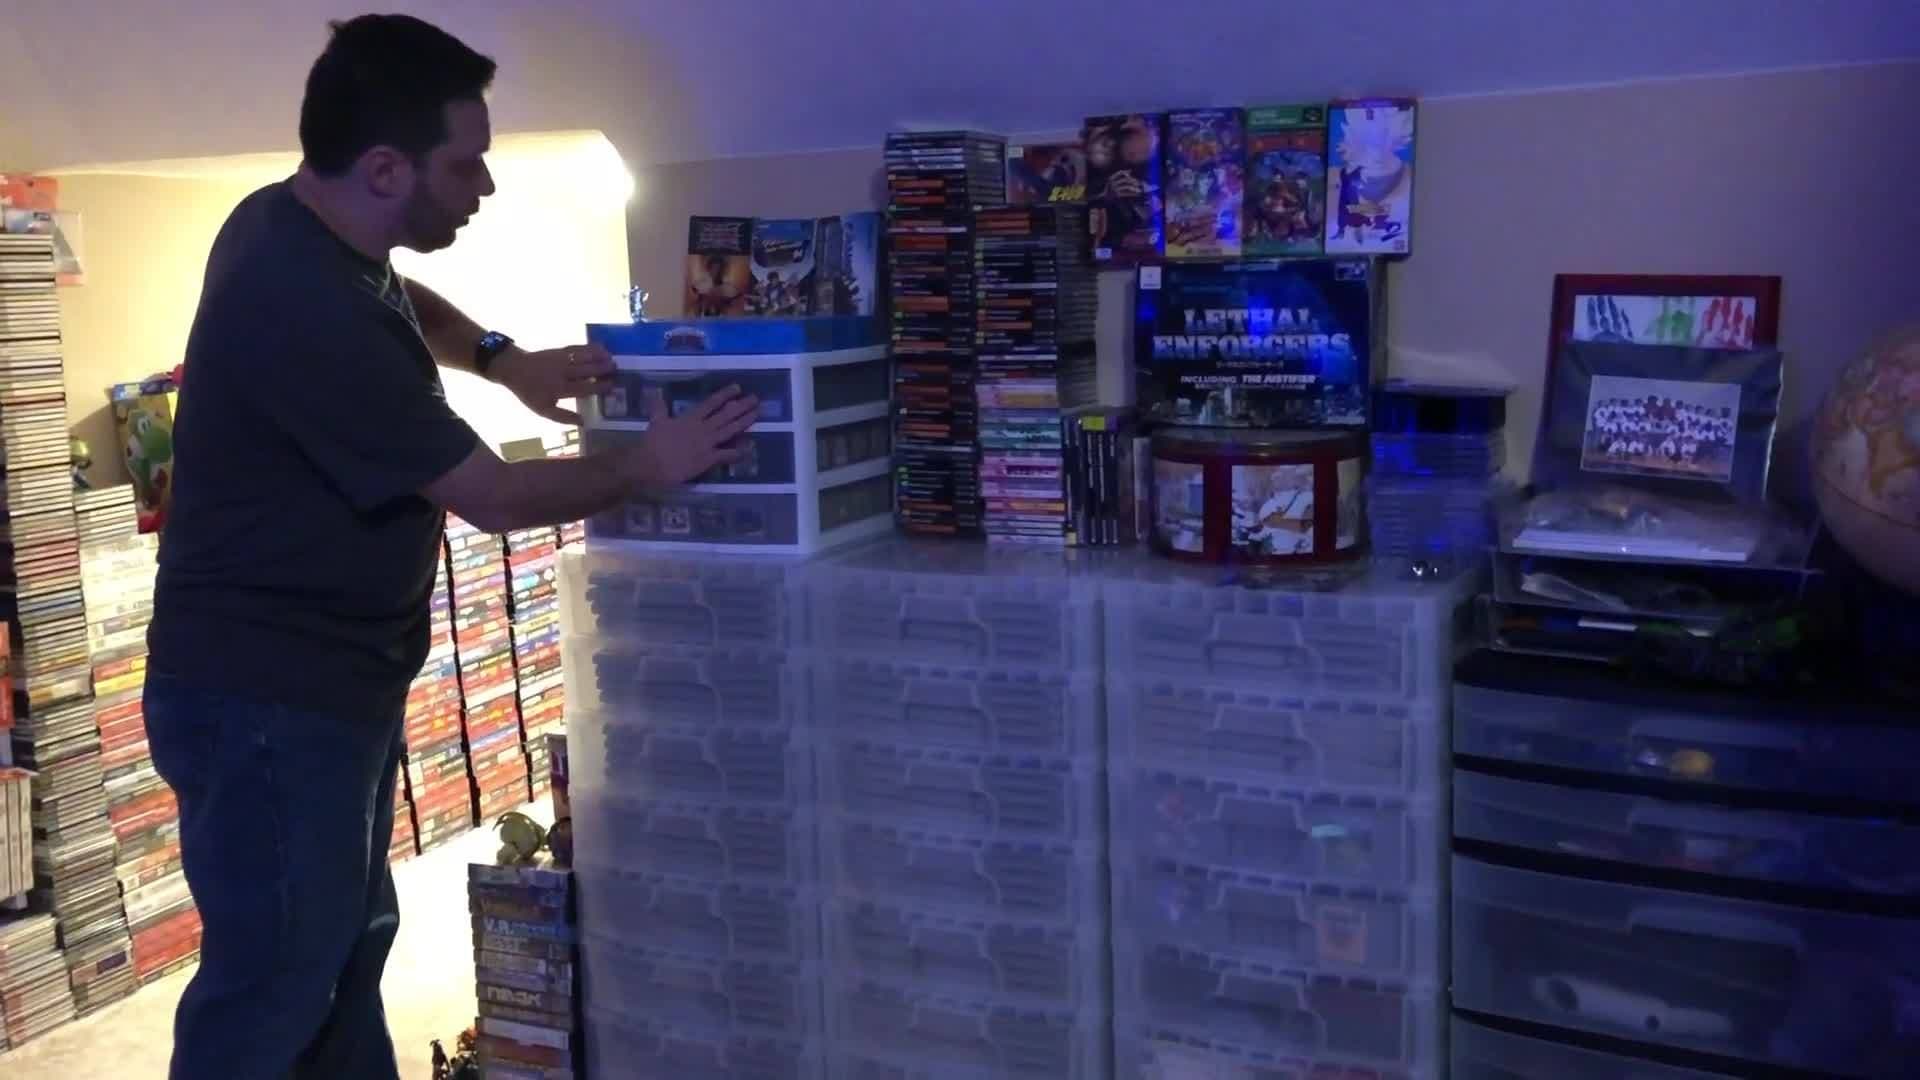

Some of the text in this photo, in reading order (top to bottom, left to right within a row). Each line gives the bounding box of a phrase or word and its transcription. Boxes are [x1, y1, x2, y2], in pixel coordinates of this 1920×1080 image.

[1183, 308, 1319, 333] LETHAL
[1153, 333, 1357, 361] ENFORCERS
[1180, 373, 1317, 384] INCLUDING THE JUSTIFIER
